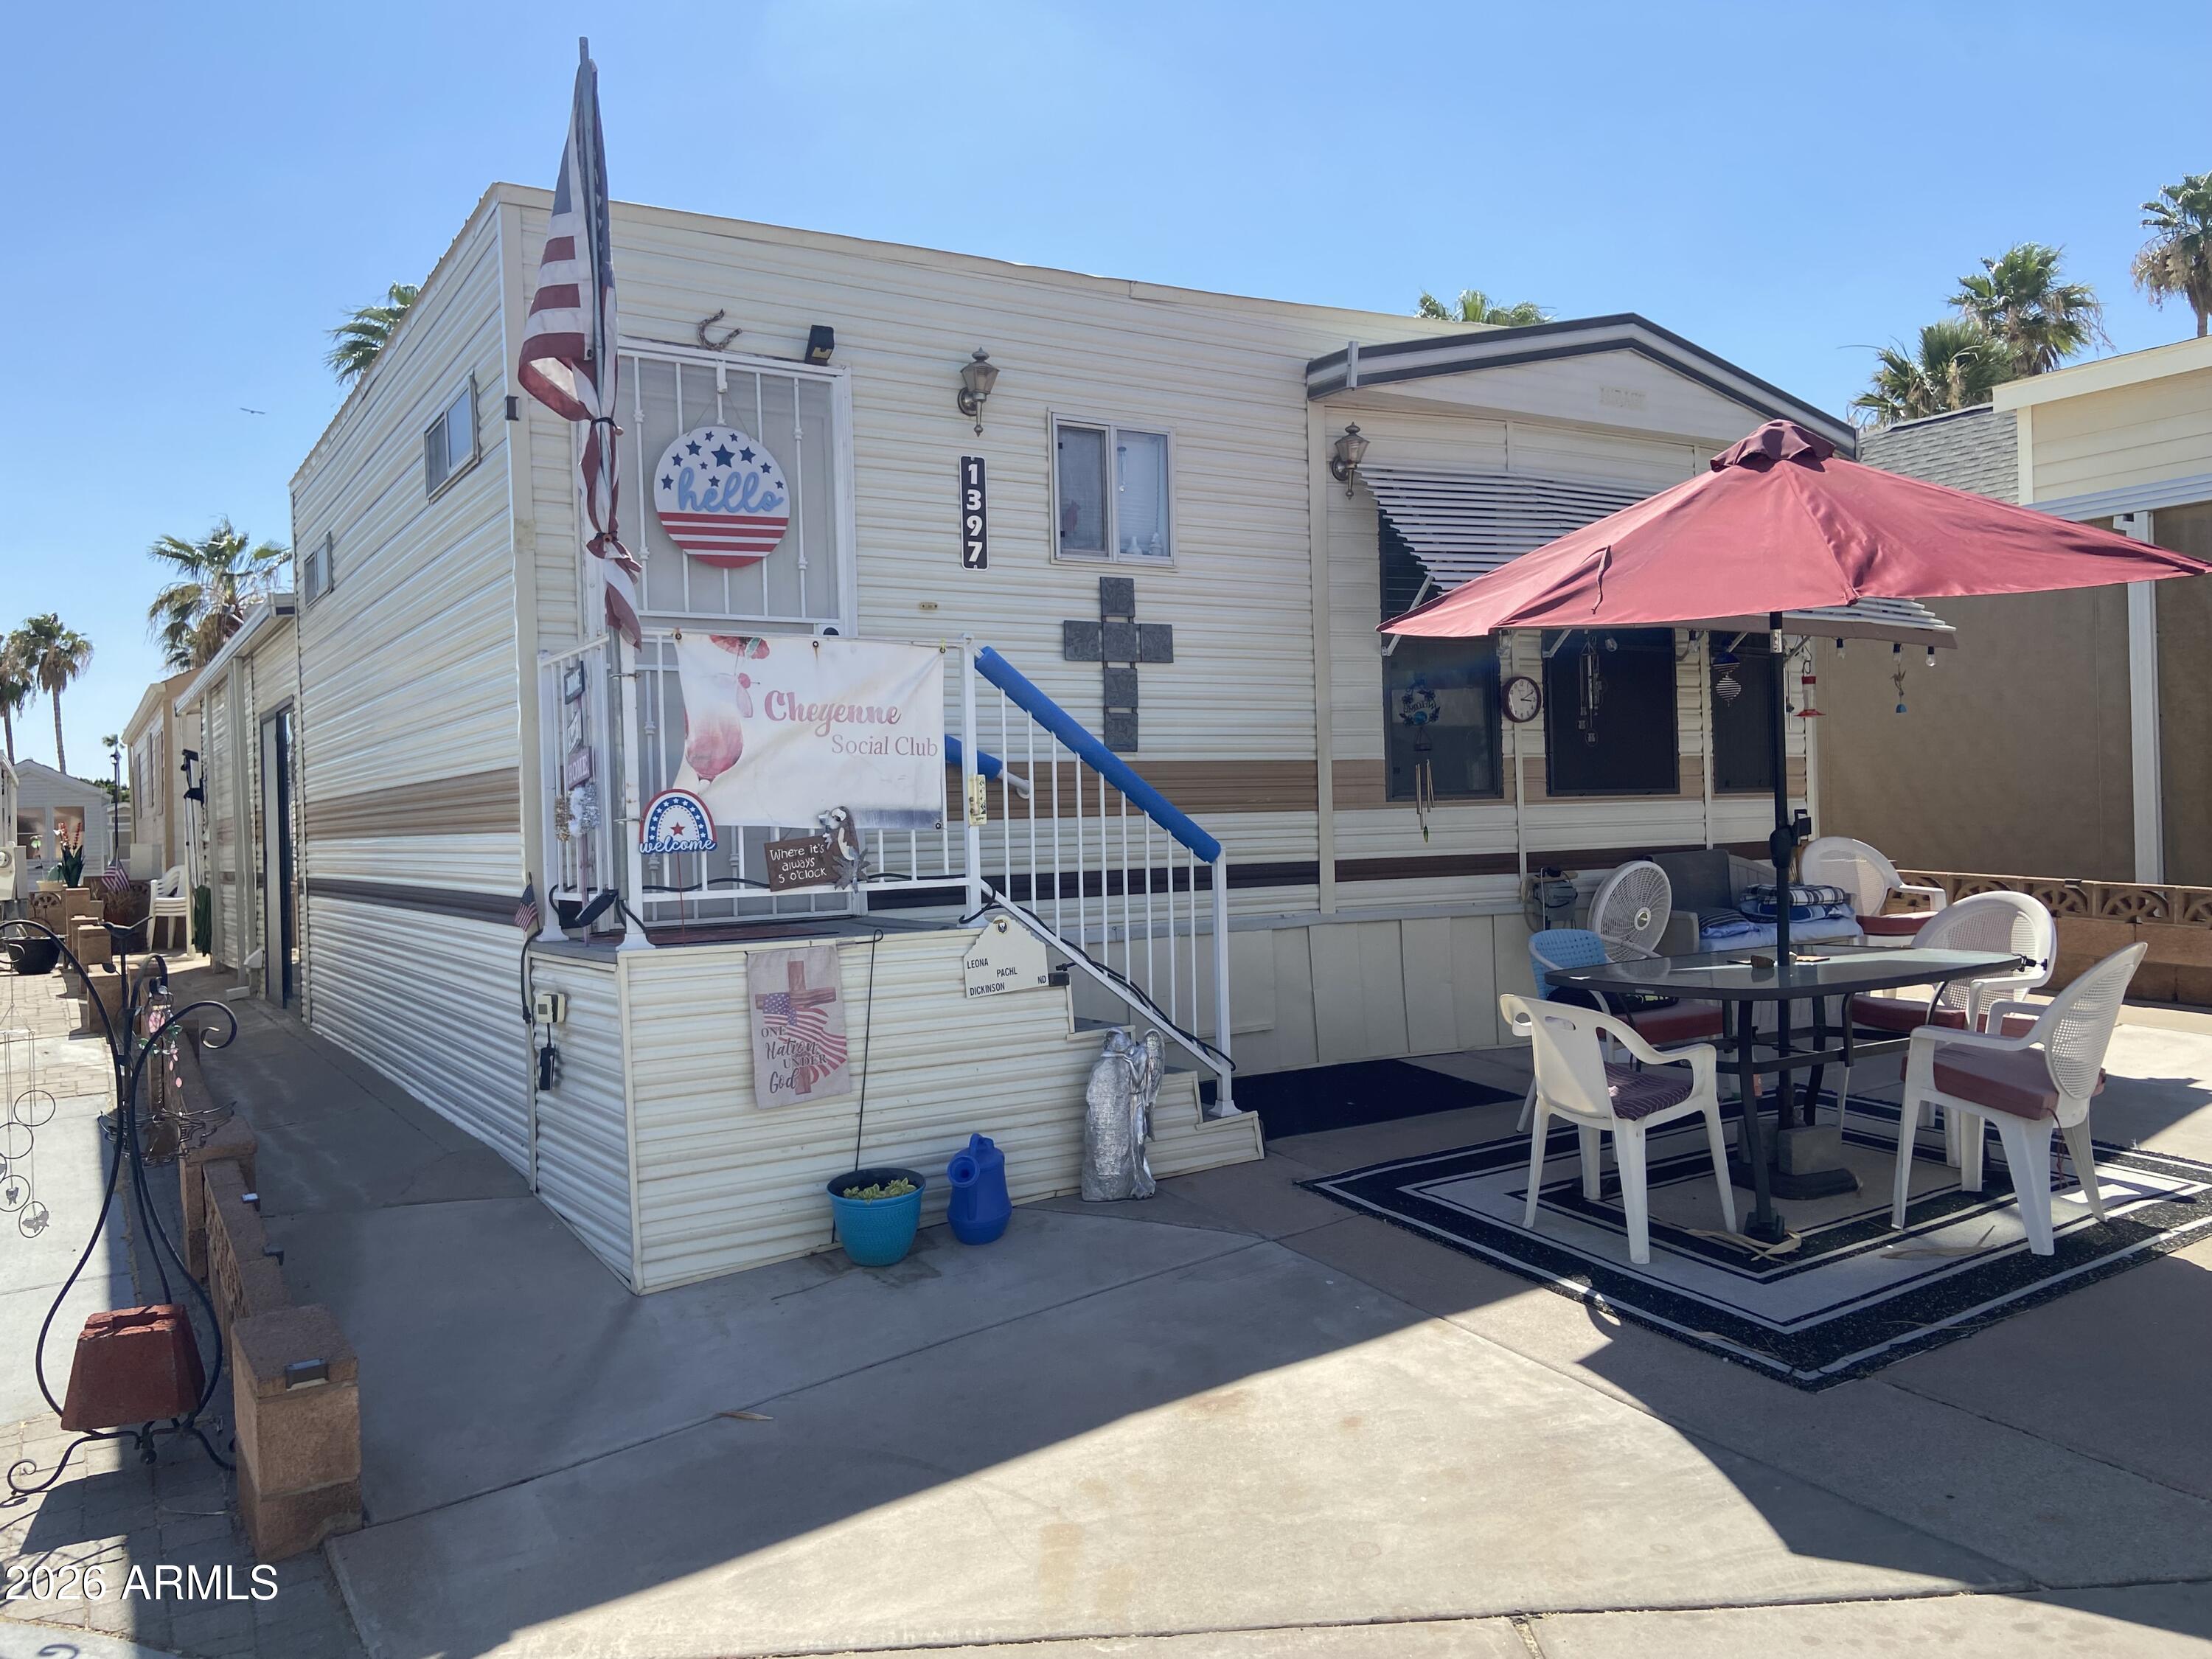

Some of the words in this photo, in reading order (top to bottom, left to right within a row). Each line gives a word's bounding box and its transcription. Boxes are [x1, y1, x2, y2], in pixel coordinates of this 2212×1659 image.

[678, 466, 785, 514] hello
[966, 463, 984, 563] 1397
[764, 689, 902, 738] Cheyenne
[831, 734, 888, 755] Social
[894, 736, 939, 757] Club
[639, 835, 716, 854] welcome
[769, 847, 805, 861] Where
[809, 843, 825, 855] it's
[779, 873, 785, 883] 5
[967, 958, 989, 970] LEONA
[996, 967, 1018, 978] PACHL
[970, 982, 1005, 996] DICKINSON
[1037, 975, 1046, 984] ND
[761, 1026, 787, 1038] ONE
[783, 1054, 827, 1069] UNDER
[769, 1068, 801, 1093] God
